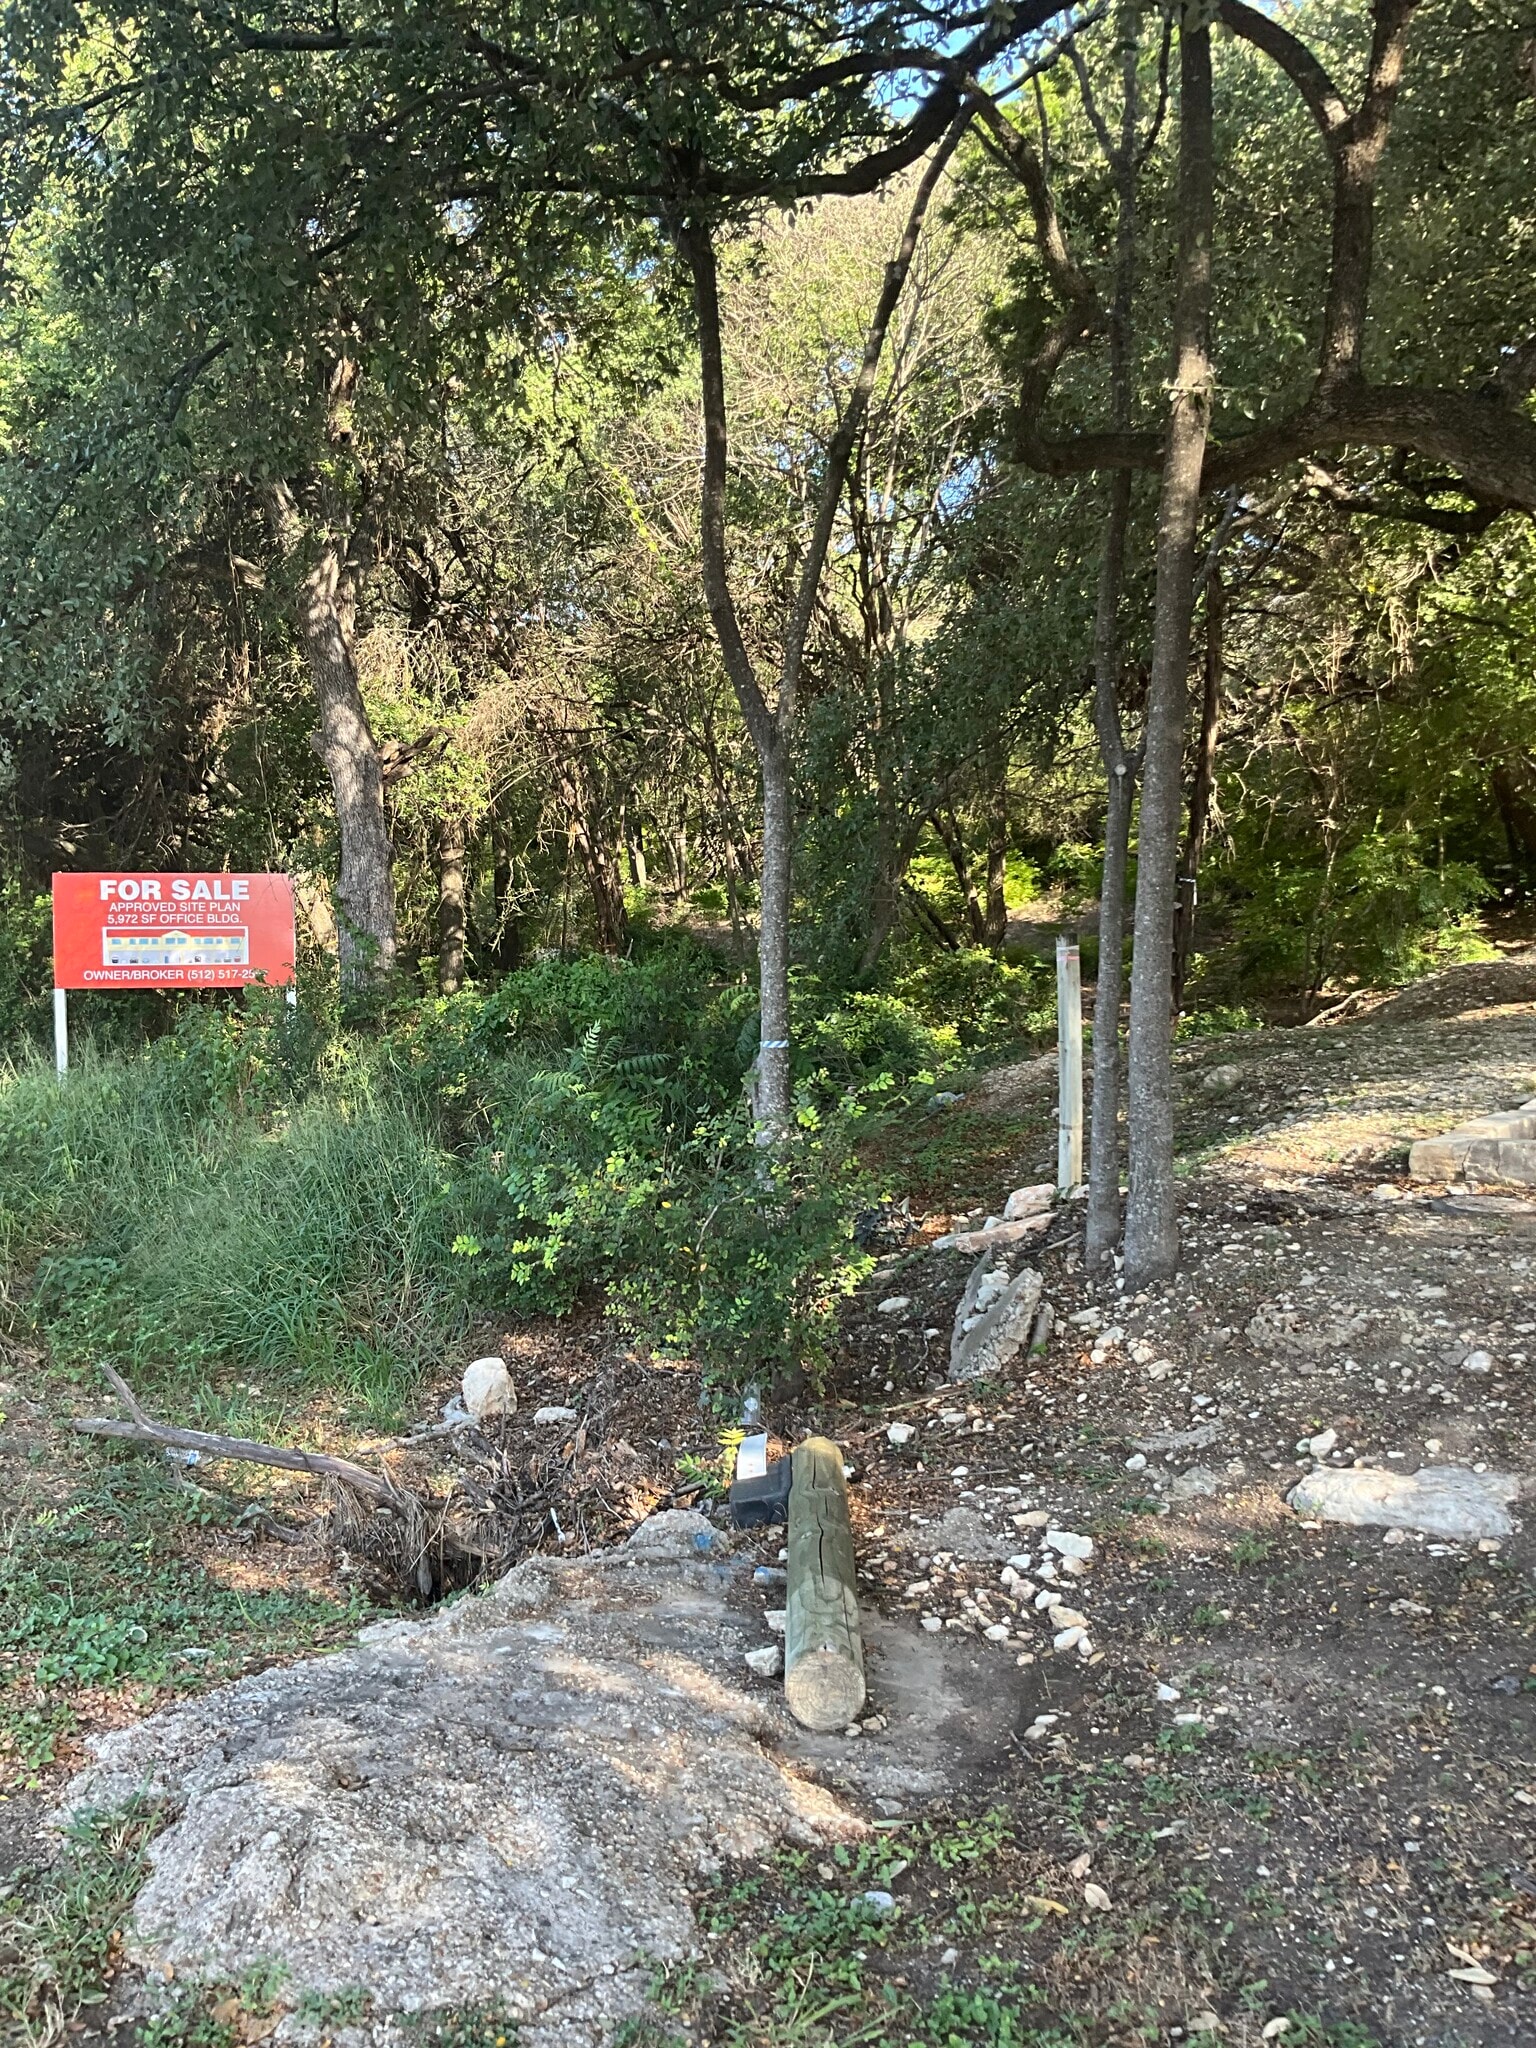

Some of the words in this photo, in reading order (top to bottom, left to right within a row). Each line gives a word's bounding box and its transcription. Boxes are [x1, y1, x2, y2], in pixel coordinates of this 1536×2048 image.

[100, 879, 161, 900] FOR
[171, 879, 249, 900] SALE
[109, 902, 176, 912] APPROVED
[179, 902, 206, 912] SITE
[209, 902, 240, 912] PLAN
[107, 914, 138, 925] 5,972
[141, 914, 157, 924] SF
[159, 913, 204, 924] OFFICE
[207, 913, 242, 923] BLDG.
[83, 970, 184, 980] OWNER/BROKER
[187, 969, 215, 981] (512)
[218, 969, 268, 979] 517-25
